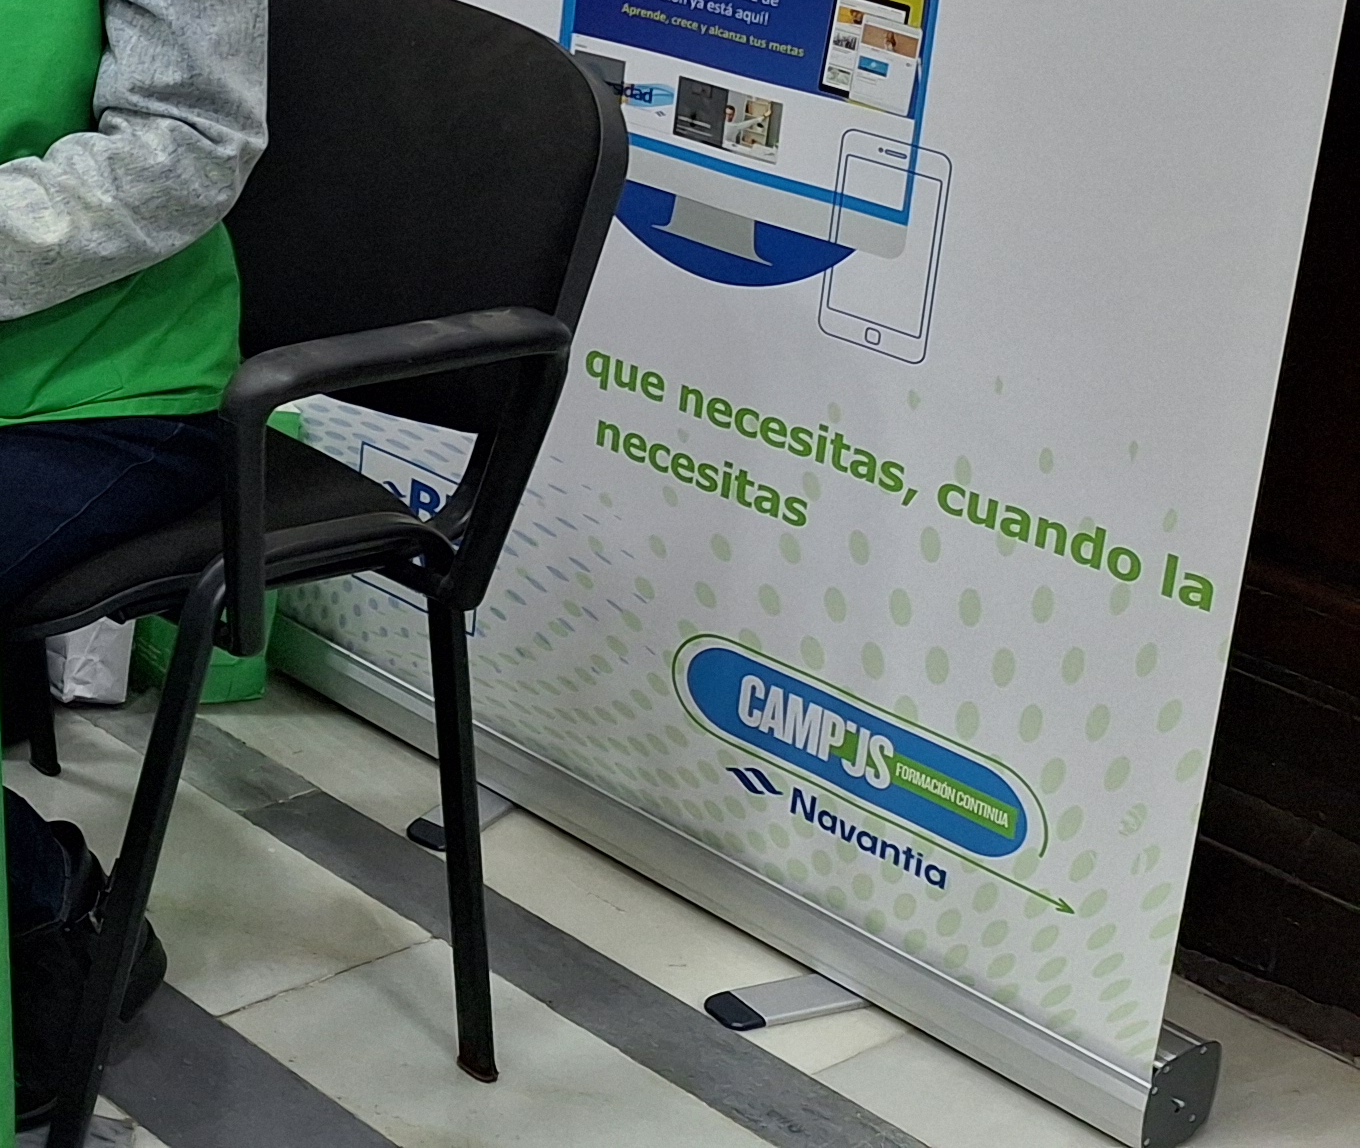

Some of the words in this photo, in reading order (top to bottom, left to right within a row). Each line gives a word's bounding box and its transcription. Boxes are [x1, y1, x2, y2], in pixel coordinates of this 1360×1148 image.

[707, 0, 733, 18] está
[586, 351, 664, 402] que
[679, 385, 918, 506] necesitas,
[938, 484, 1141, 581] cuando
[1162, 554, 1213, 612] la
[595, 415, 810, 526] necesitas
[789, 786, 948, 891] Navantia
[896, 761, 956, 803] FORMACIÓN
[955, 789, 1010, 829] CONTINUA
